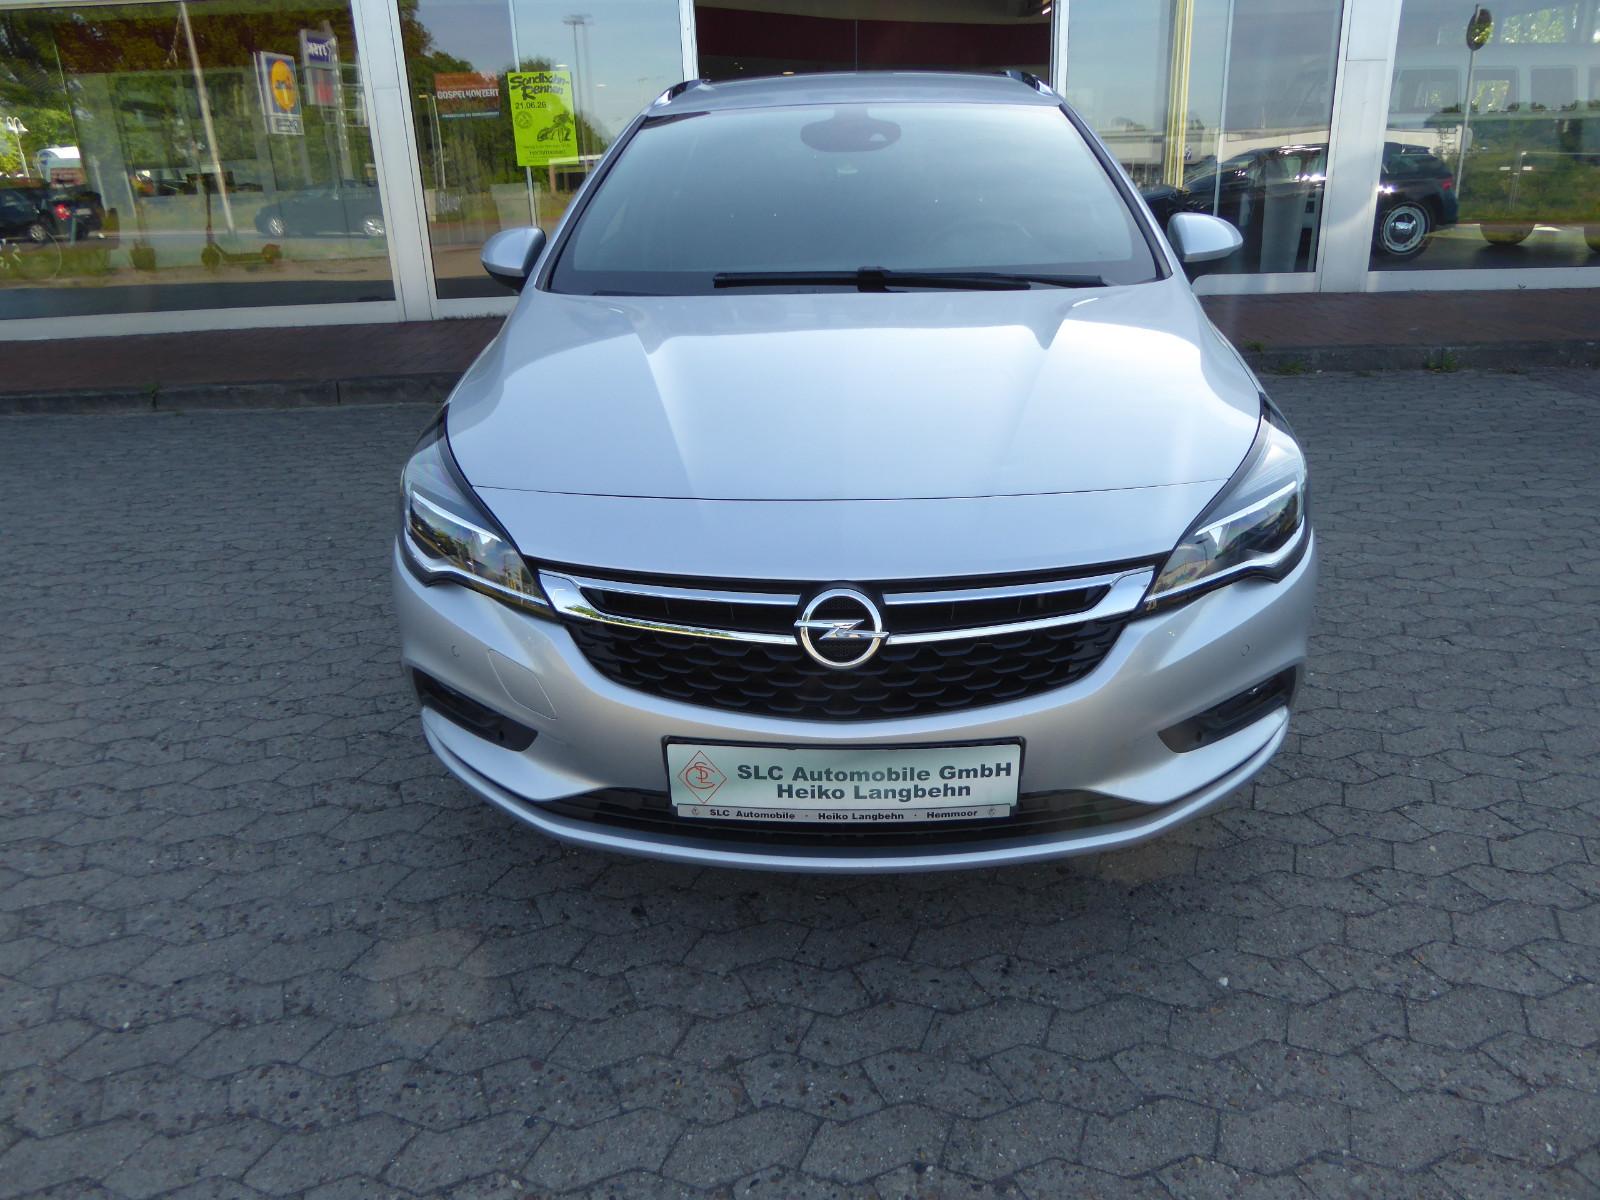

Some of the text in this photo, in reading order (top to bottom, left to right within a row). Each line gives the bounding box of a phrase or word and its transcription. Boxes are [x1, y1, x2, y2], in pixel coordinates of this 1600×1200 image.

[737, 762, 1012, 782] SLC Automobile GmbH
[777, 783, 971, 803] Heiko Langbehn
[710, 808, 730, 817] SLC
[736, 810, 796, 819] Automobile
[818, 812, 849, 820] Heiko
[852, 812, 904, 821] Langbehn
[926, 809, 978, 819] Hemmoor
